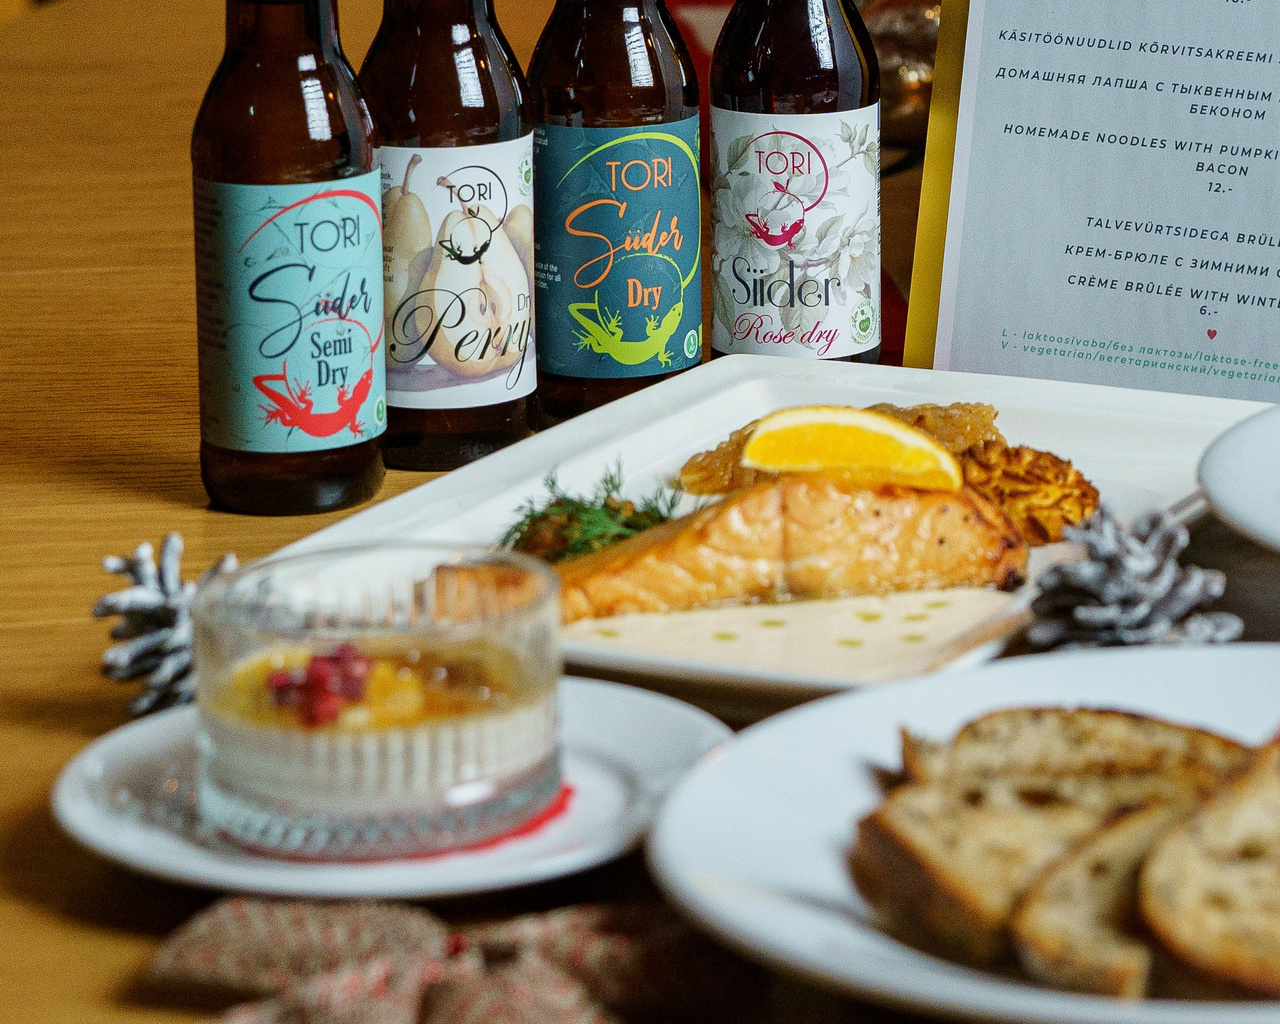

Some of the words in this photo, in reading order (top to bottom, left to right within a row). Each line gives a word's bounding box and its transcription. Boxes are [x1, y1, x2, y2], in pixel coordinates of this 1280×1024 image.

[998, 28, 1133, 52] KÄSITÖÖNUUDLID
[1138, 40, 1274, 64] KÕRVITSAKREEMI
[994, 66, 1087, 85] ДОМАШНЯЯ
[1091, 75, 1148, 91] ЛАПША
[1171, 82, 1273, 102] ТЫКВЕННЫМ
[1189, 103, 1267, 121] БЕКОНОМ
[1003, 123, 1091, 142] HOMEMADE
[1095, 132, 1168, 150] NOODLES
[1174, 140, 1214, 154] WITH
[605, 156, 672, 192] TORI
[754, 150, 811, 175] TORI
[1195, 161, 1249, 177] BACON
[446, 182, 492, 204] TORI
[1207, 181, 1233, 194] 12.-
[294, 215, 360, 254] TORI
[565, 198, 684, 289] Siider
[1086, 216, 1229, 242] TALVEVÜRTSIDEGA
[1064, 244, 1169, 266] КРЕМ-БРЮЛЕ
[1189, 258, 1270, 277] ЗИМНИМИ
[627, 278, 663, 311] Dry
[732, 256, 841, 308] Siider
[1067, 274, 1119, 290] CRÈME
[1124, 280, 1184, 298] BRÛLÉE
[1190, 288, 1230, 303] WITH
[249, 263, 372, 359] Siider
[1199, 304, 1218, 316] 6.-
[310, 328, 353, 359] Semi
[389, 287, 532, 390] Perry
[733, 312, 801, 345] Rosé
[800, 320, 841, 357] dry
[1001, 328, 1008, 338] L
[1001, 340, 1010, 350] V
[317, 360, 349, 388] Dry
